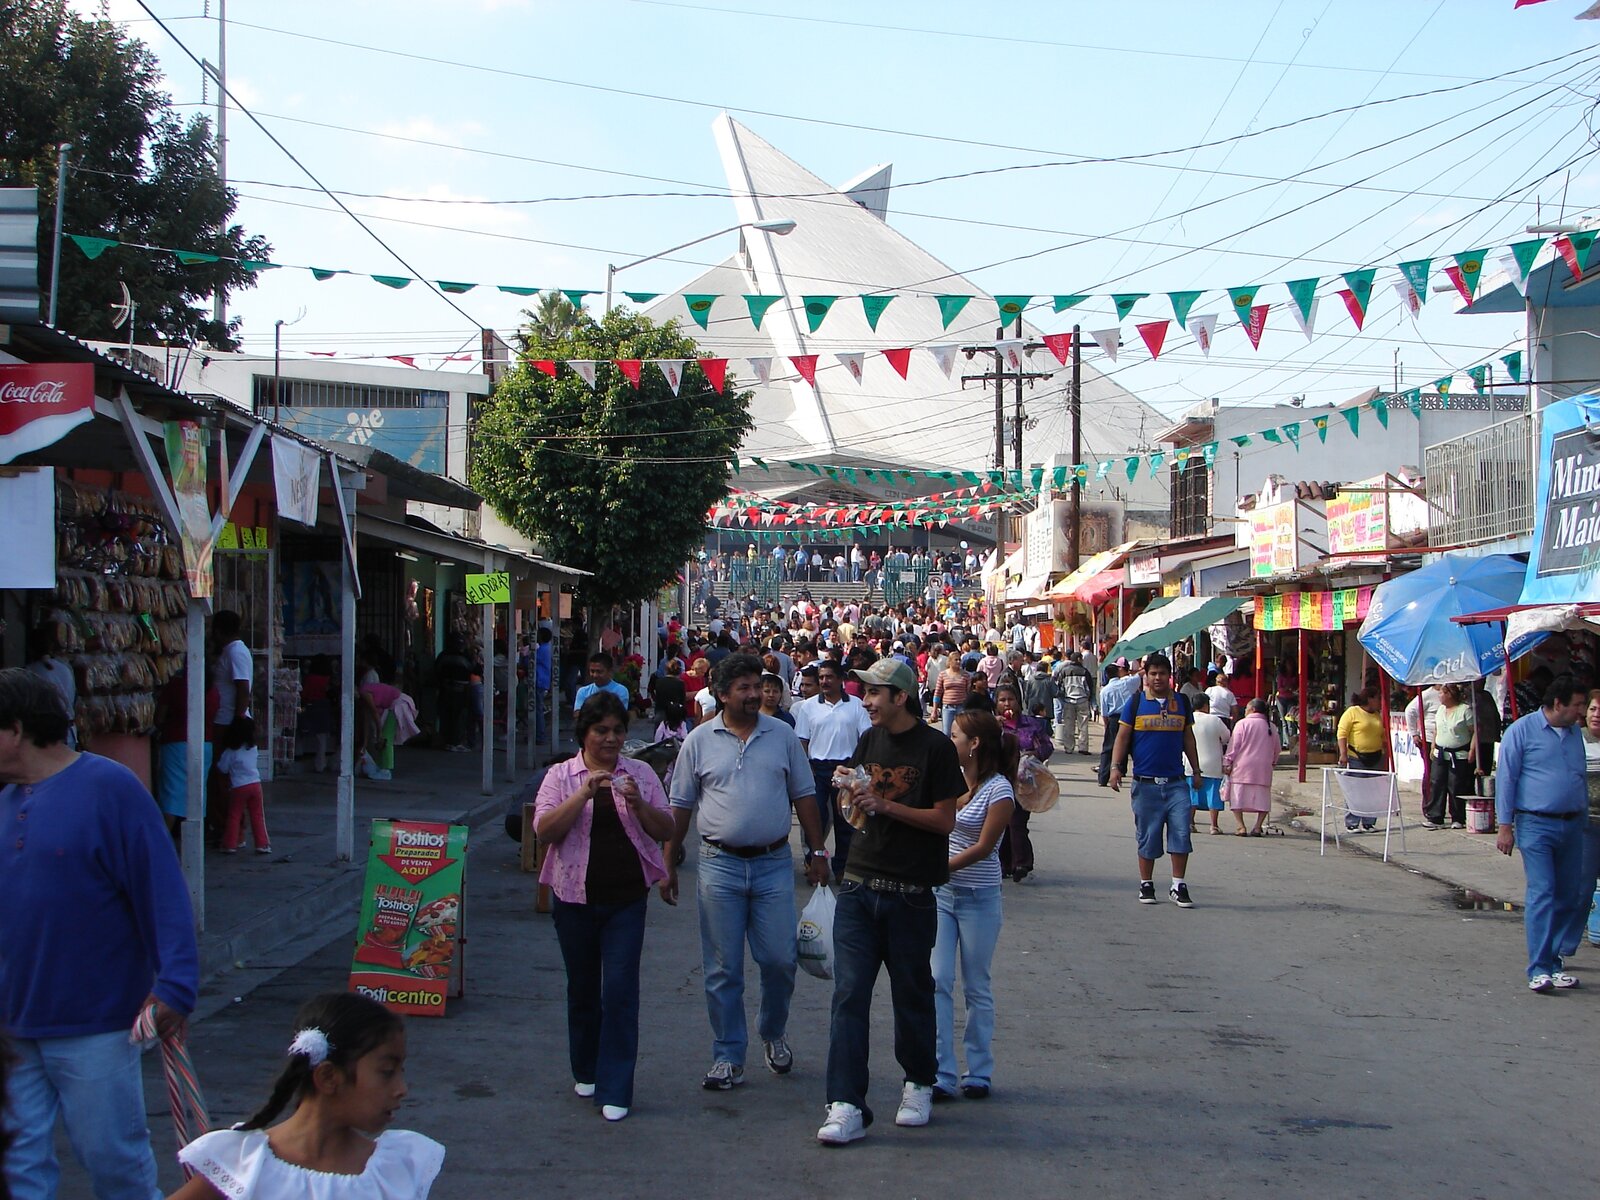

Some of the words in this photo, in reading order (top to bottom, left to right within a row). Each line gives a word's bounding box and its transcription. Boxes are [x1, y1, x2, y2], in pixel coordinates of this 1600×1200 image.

[0, 381, 67, 404] Coca-Cola
[1481, 651, 1492, 661] EN
[1433, 651, 1465, 679] Ciel
[1144, 717, 1182, 728] TIGRES
[396, 830, 445, 848] Tostitos
[395, 847, 440, 858] Preparados
[401, 859, 411, 867] DE
[411, 859, 432, 867] VENTA
[377, 896, 415, 912] Tostitos
[356, 985, 443, 1006] Tosticentro
